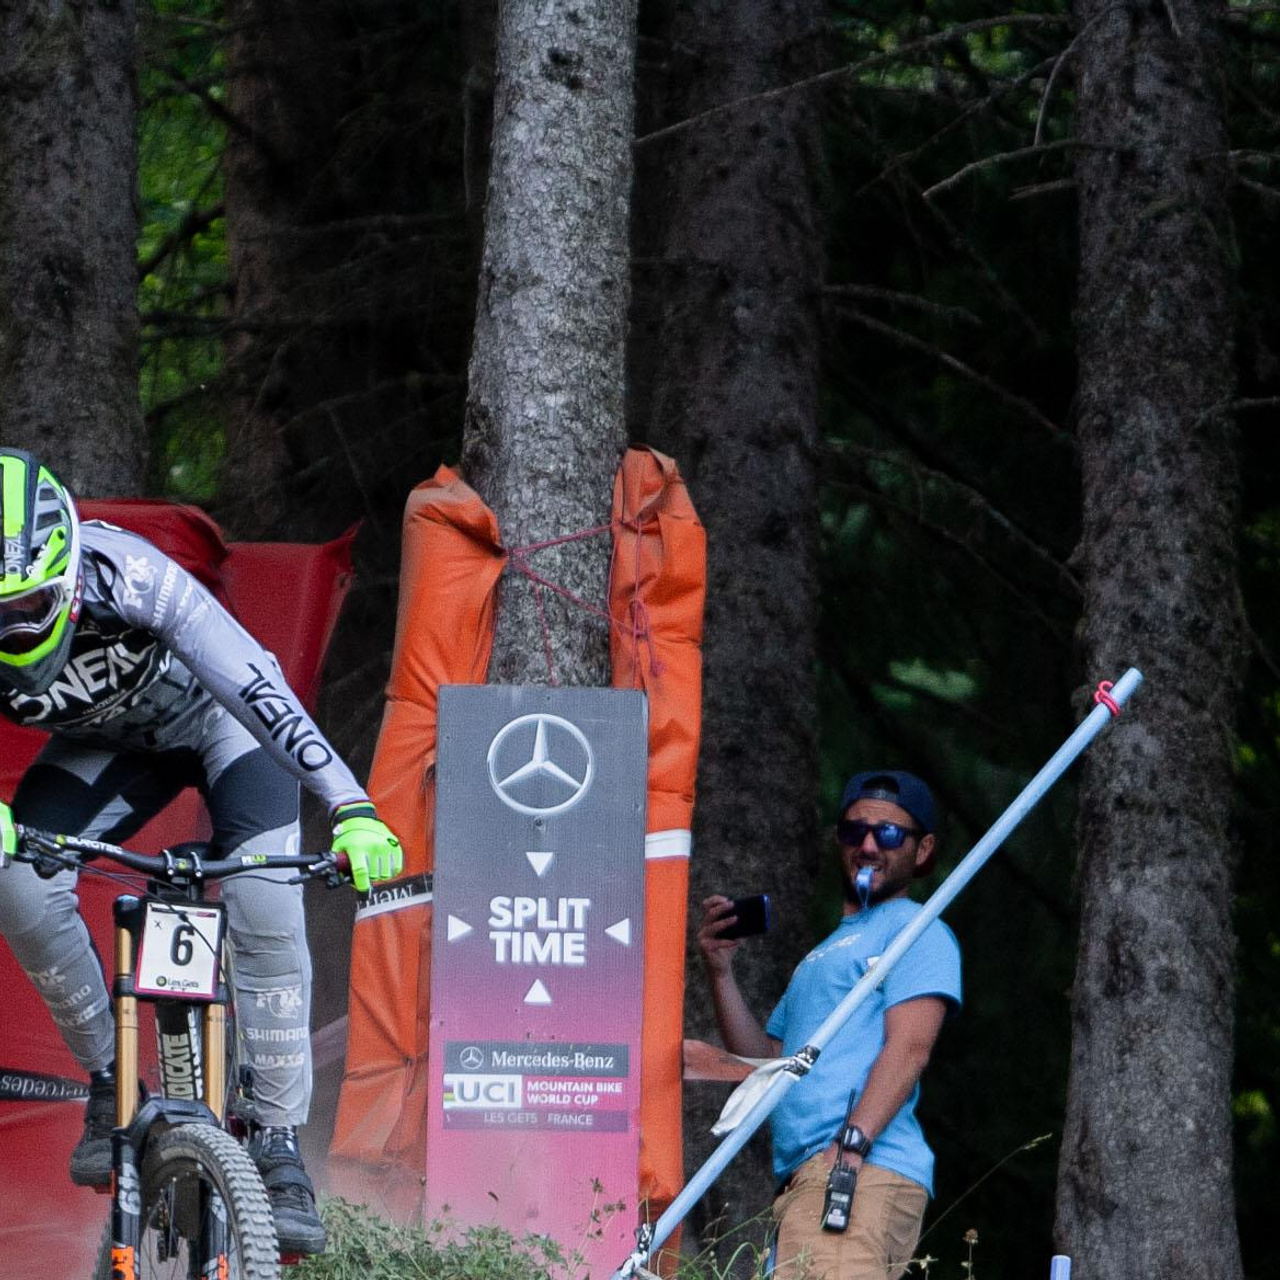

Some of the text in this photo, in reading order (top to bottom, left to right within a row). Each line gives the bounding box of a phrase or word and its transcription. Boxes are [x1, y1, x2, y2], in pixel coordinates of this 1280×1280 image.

[239, 662, 332, 771] ONEAL
[488, 896, 590, 929] SPLIT
[170, 924, 195, 967] 6
[489, 931, 586, 964] TIME
[491, 1050, 614, 1070] Mercedes-Benz
[457, 1081, 516, 1103] UCI
[527, 1081, 623, 1093] MOUNTAIN BIKE
[527, 1093, 598, 1105] WORLD CUP
[484, 1112, 594, 1126] LES GETS FRANCE
